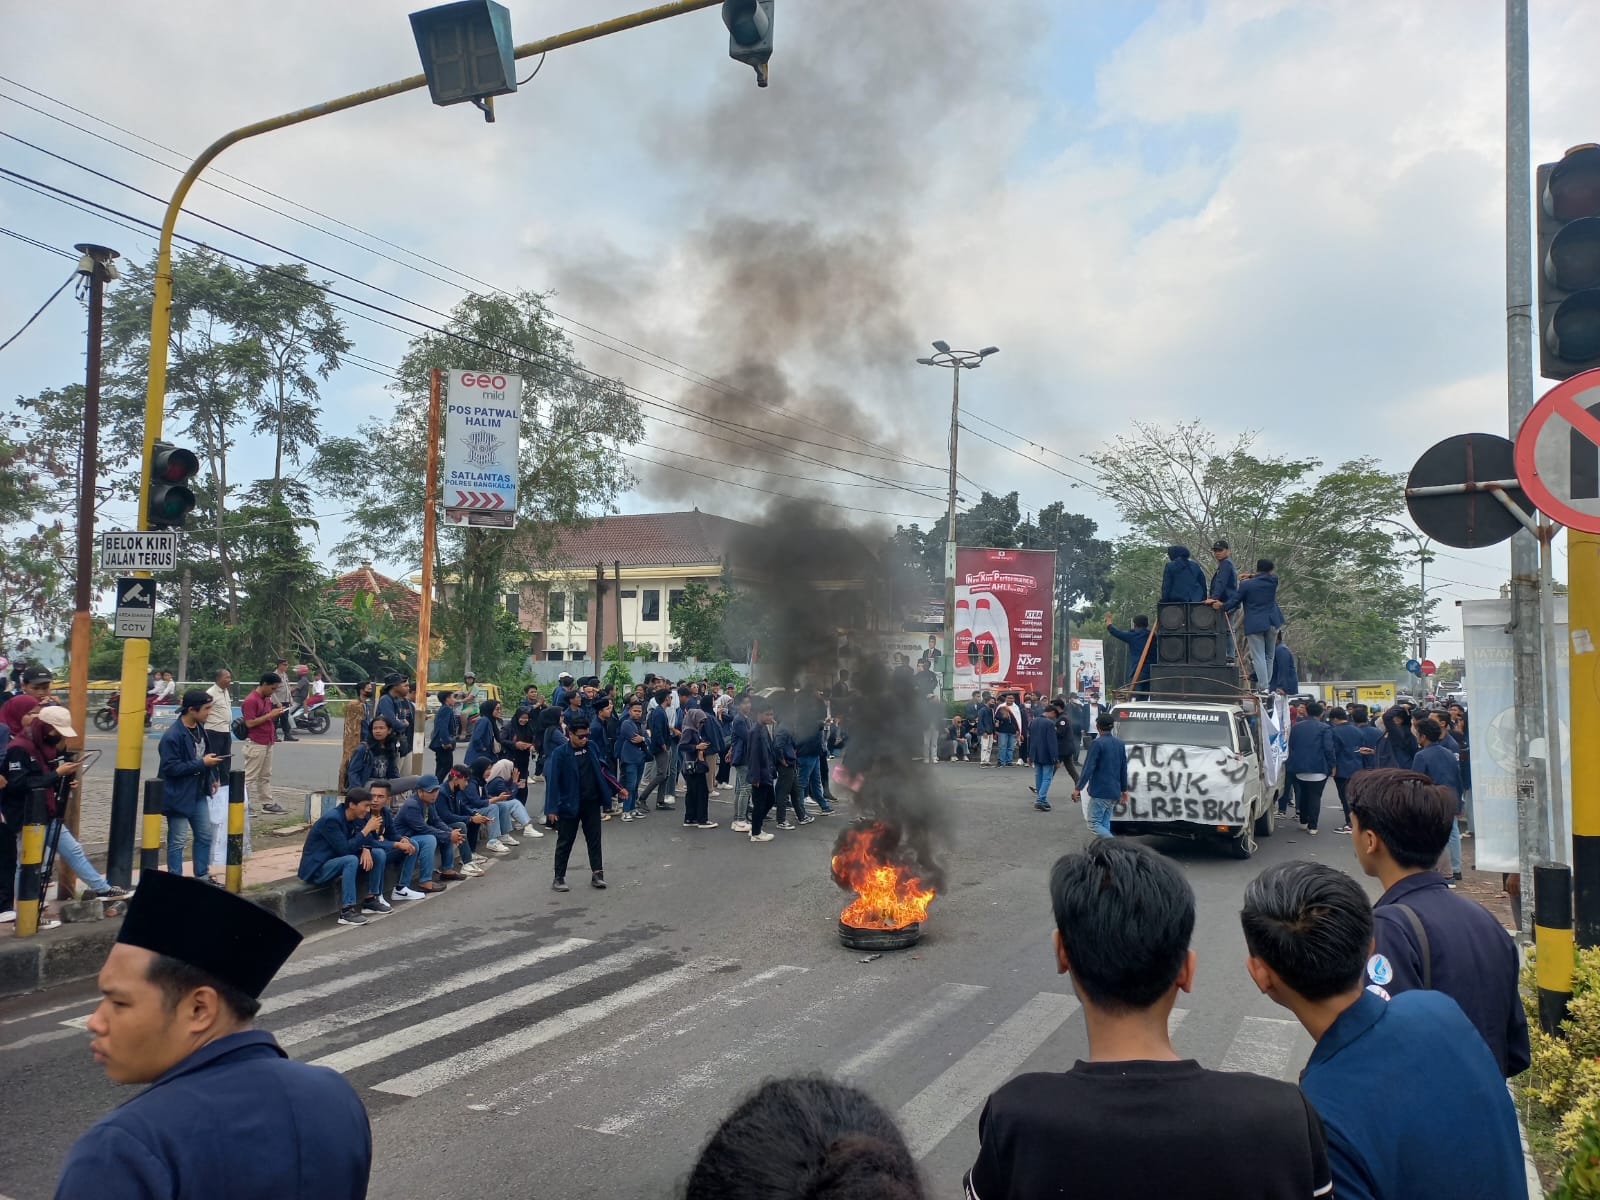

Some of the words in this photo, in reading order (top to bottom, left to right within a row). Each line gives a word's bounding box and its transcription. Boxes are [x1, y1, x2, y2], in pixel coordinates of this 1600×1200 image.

[483, 391, 505, 400] mild
[448, 405, 471, 415] POS
[474, 407, 519, 419] PATWAL
[465, 417, 501, 428] HALIM
[451, 471, 511, 482] SATLANTAS
[473, 481, 516, 489] BANGKALAN
[106, 537, 143, 550] BELOK
[146, 537, 172, 550] KIRI
[105, 552, 136, 566] JALAN
[138, 552, 172, 566] TERUS
[121, 623, 146, 632] CCTV
[1017, 657, 1042, 665] NXP
[1177, 713, 1220, 722] BANGKALAN
